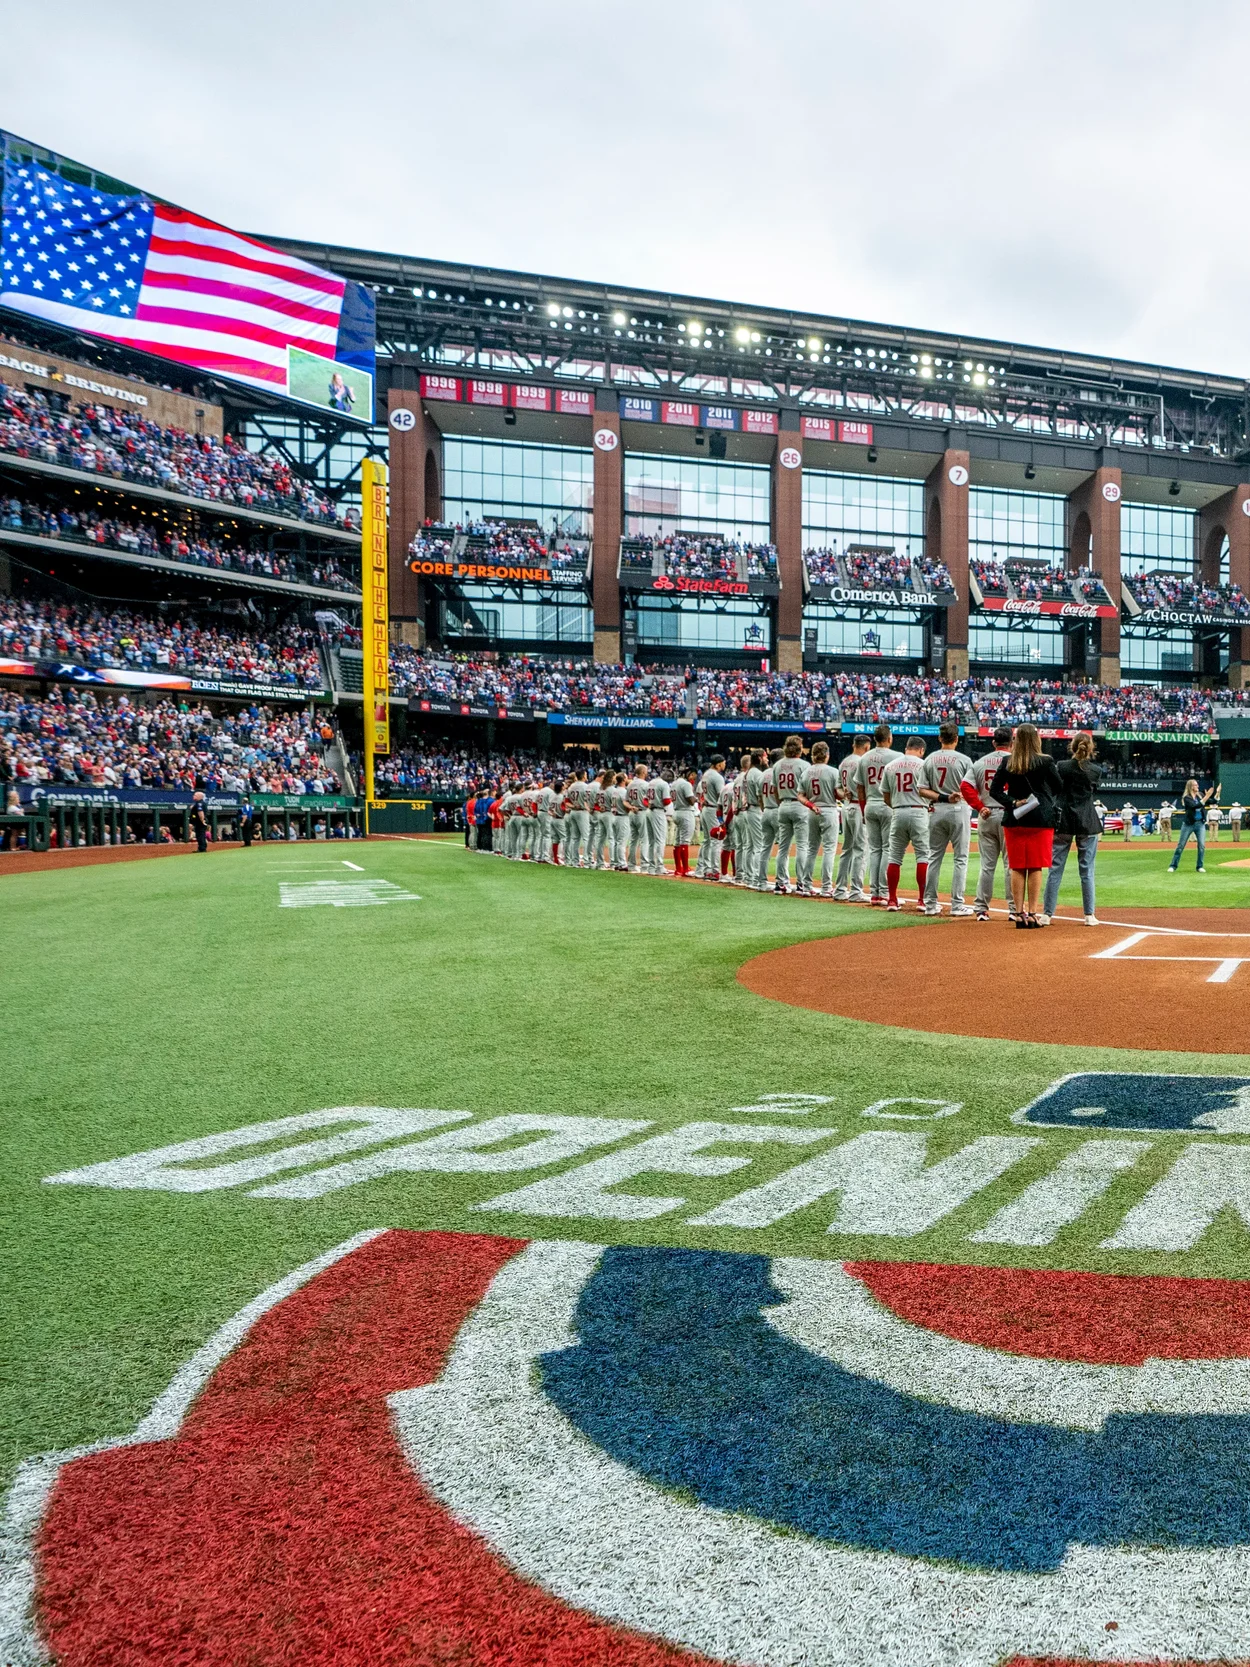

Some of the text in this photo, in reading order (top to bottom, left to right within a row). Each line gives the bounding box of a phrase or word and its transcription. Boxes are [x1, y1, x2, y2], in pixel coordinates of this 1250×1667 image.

[425, 375, 456, 390] 1996
[472, 380, 503, 394] 1998
[64, 373, 148, 407] BREWING
[516, 385, 546, 399] 1999
[561, 391, 590, 404] 2010
[625, 397, 652, 410] 2010
[668, 402, 693, 415] 2011
[707, 406, 732, 419] 2011
[393, 413, 412, 426] 42
[747, 411, 773, 423] 2012
[805, 417, 830, 430] 2015
[843, 422, 867, 434] 2016
[597, 433, 615, 447] 34
[782, 452, 798, 464] 26
[955, 470, 962, 481] 7
[1105, 486, 1118, 498] 29
[374, 487, 384, 567] BRING
[410, 560, 551, 581] CORE PERSONNEL
[375, 572, 384, 620] THE
[900, 591, 938, 605] Bank
[1151, 609, 1213, 624] CHOCTAW
[376, 623, 385, 688] HEAT
[255, 684, 273, 692] PROOF
[273, 686, 299, 694] THROUGH
[431, 703, 451, 711] TOYOTA
[470, 707, 489, 715] TOYOTA
[1117, 731, 1210, 743] LUXOR STAFFING
[779, 773, 795, 789] 28
[895, 772, 914, 793] 12
[937, 767, 947, 788] 7
[811, 778, 821, 796] 5
